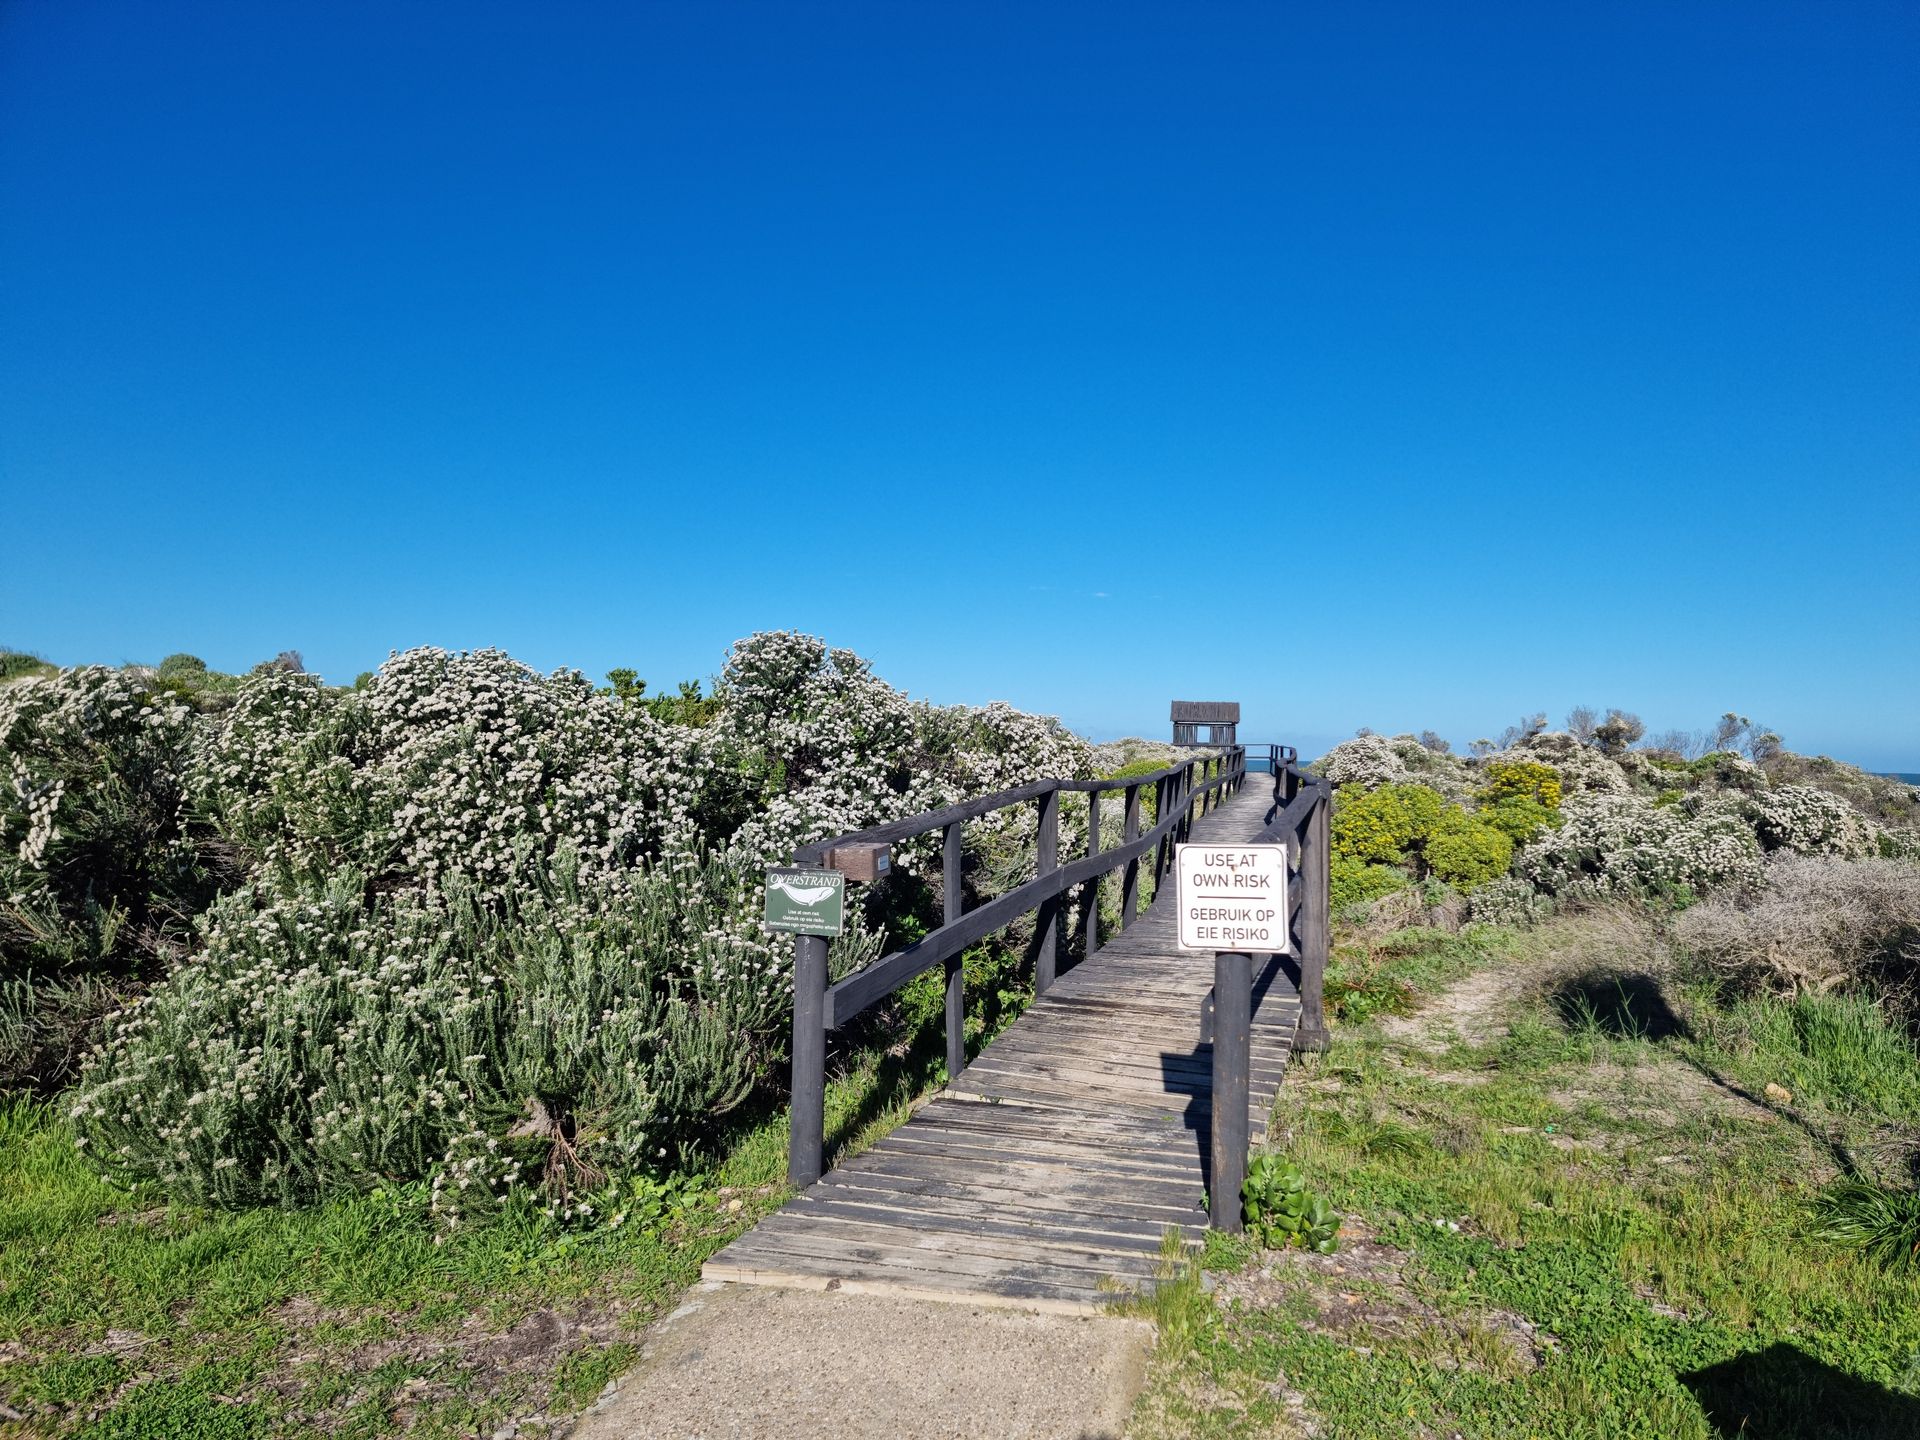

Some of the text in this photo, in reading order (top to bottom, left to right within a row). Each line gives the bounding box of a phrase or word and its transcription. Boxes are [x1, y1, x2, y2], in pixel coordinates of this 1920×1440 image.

[1204, 853, 1258, 867] USE AT
[770, 873, 841, 887] OVERSTRAND
[1193, 873, 1271, 888] OWN RISK
[1190, 907, 1275, 922] GEBRUIK OP
[1197, 926, 1269, 941] EIE RISIKO
